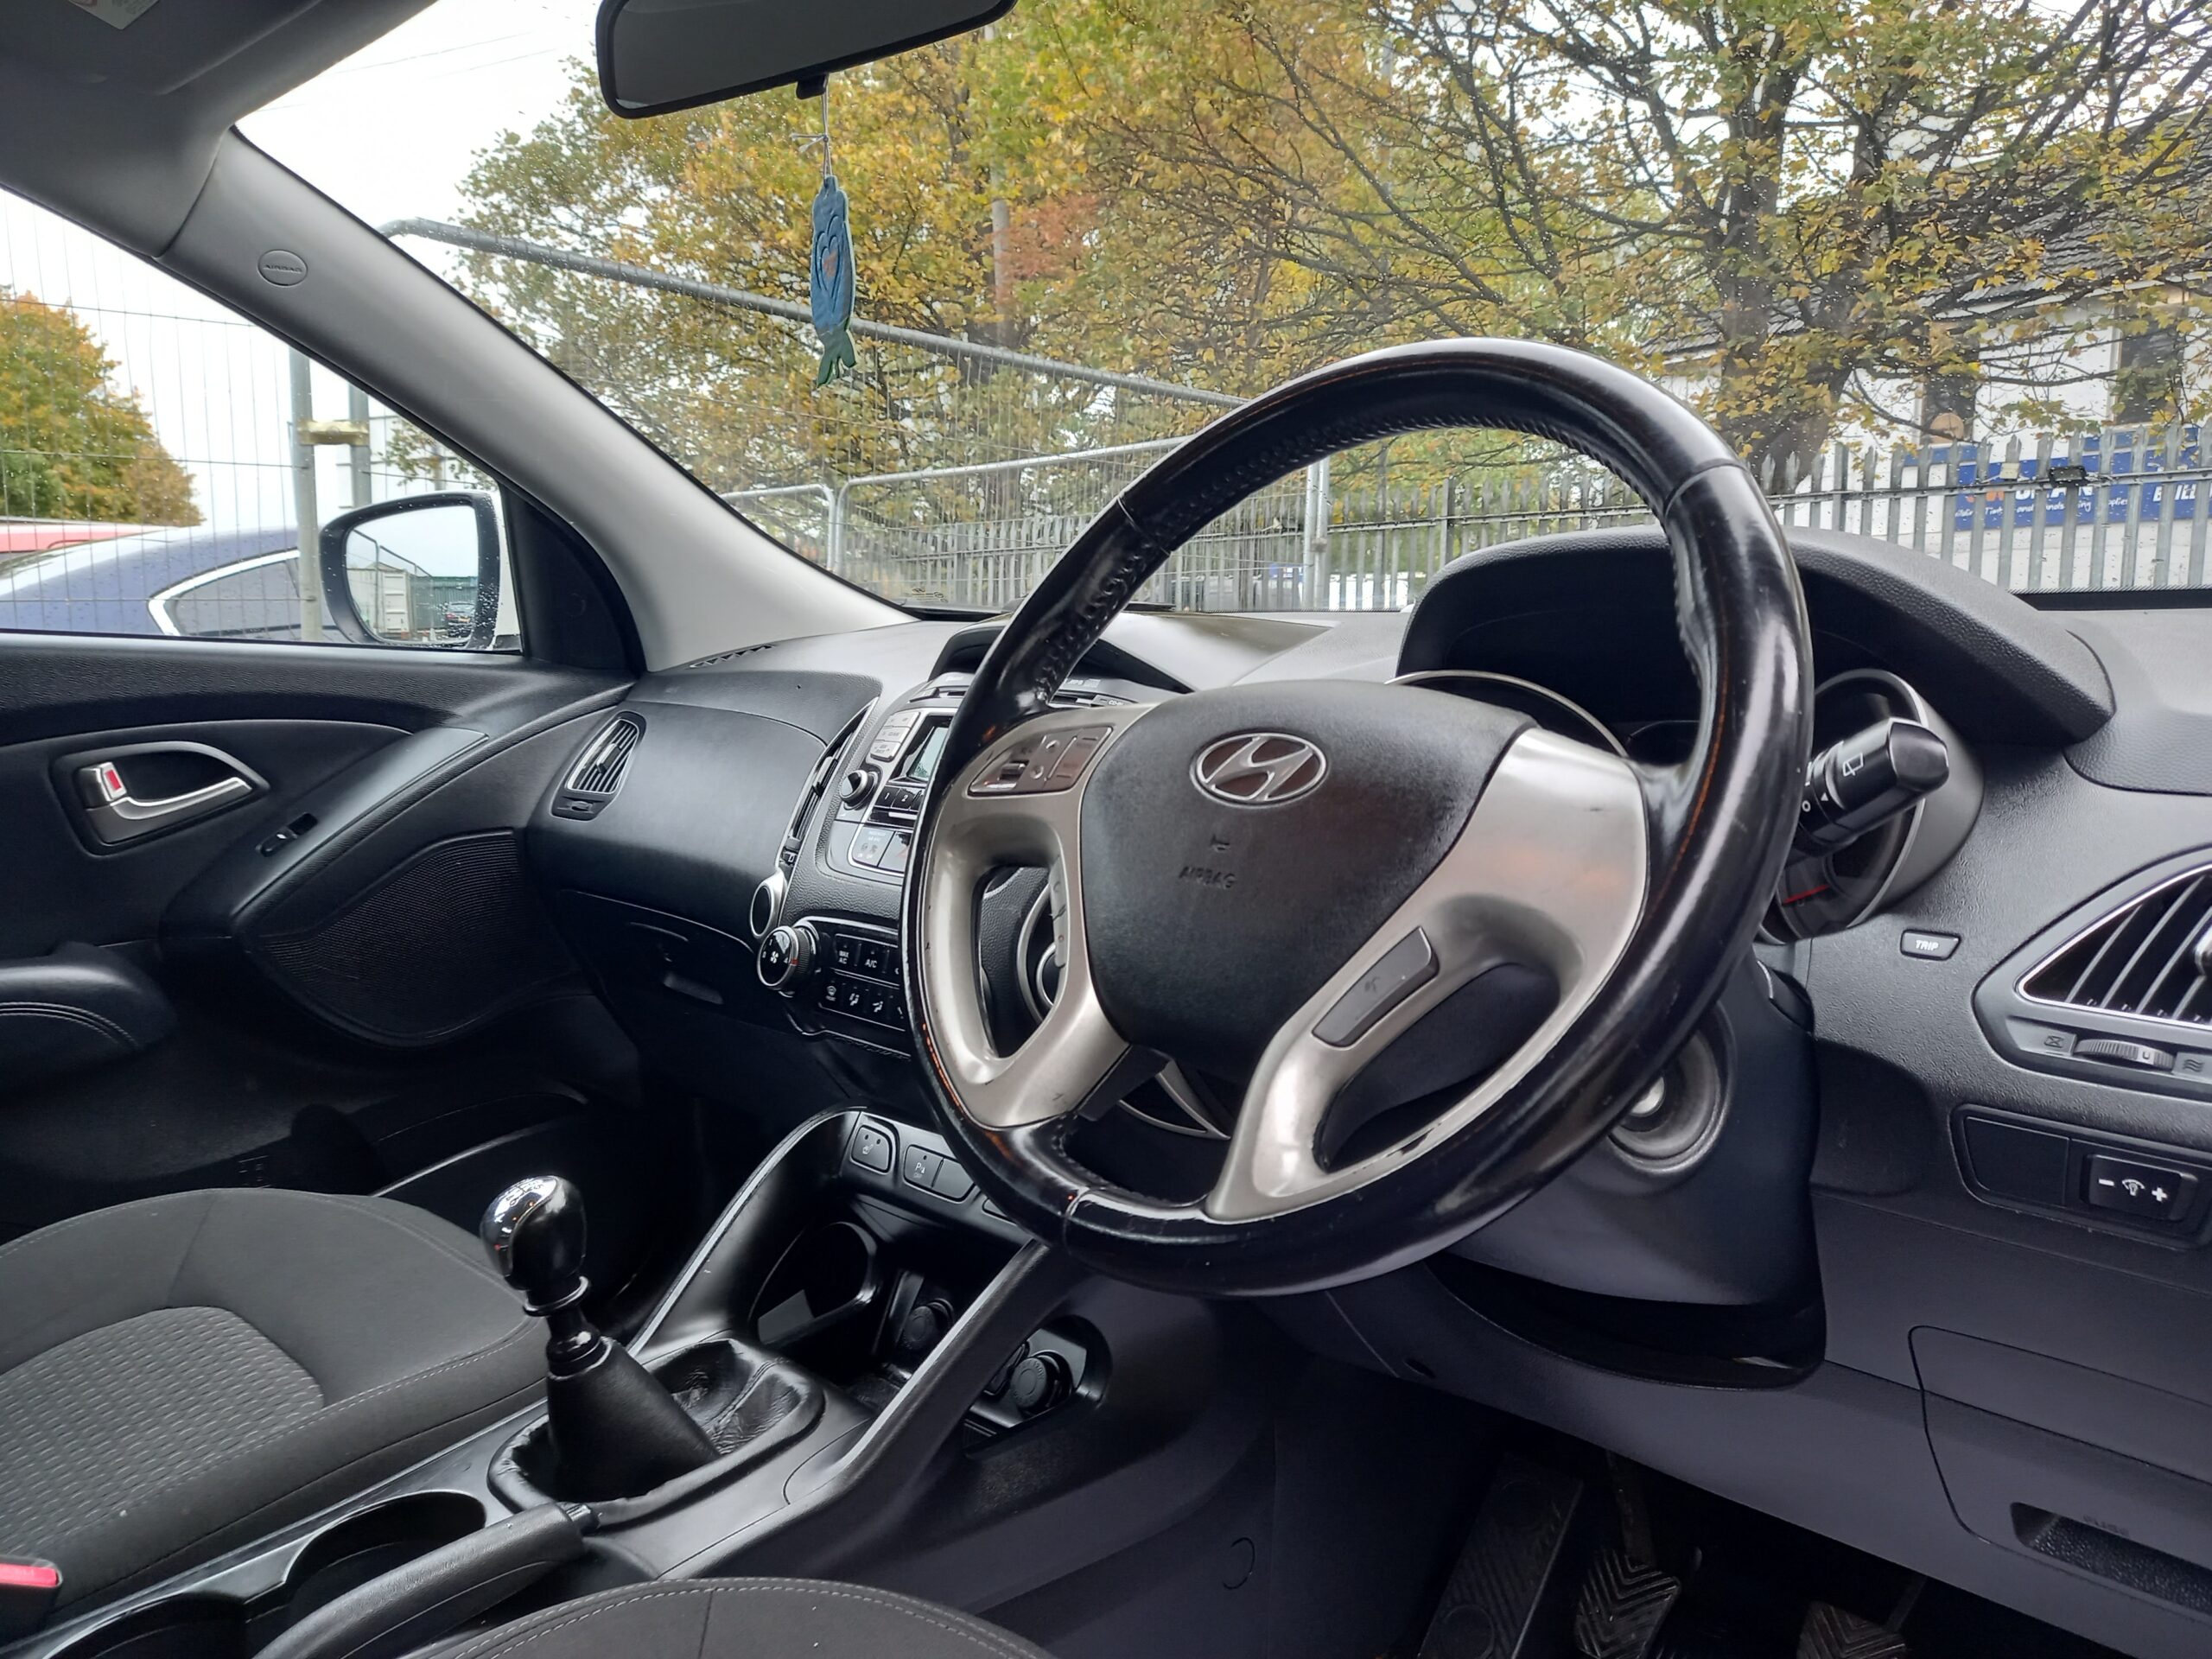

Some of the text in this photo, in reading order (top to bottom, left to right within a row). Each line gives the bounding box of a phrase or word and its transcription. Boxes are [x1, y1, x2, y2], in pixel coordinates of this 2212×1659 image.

[900, 793, 909, 803] 2
[1916, 939, 1939, 951] TRIP
[864, 958, 878, 969] A/C
